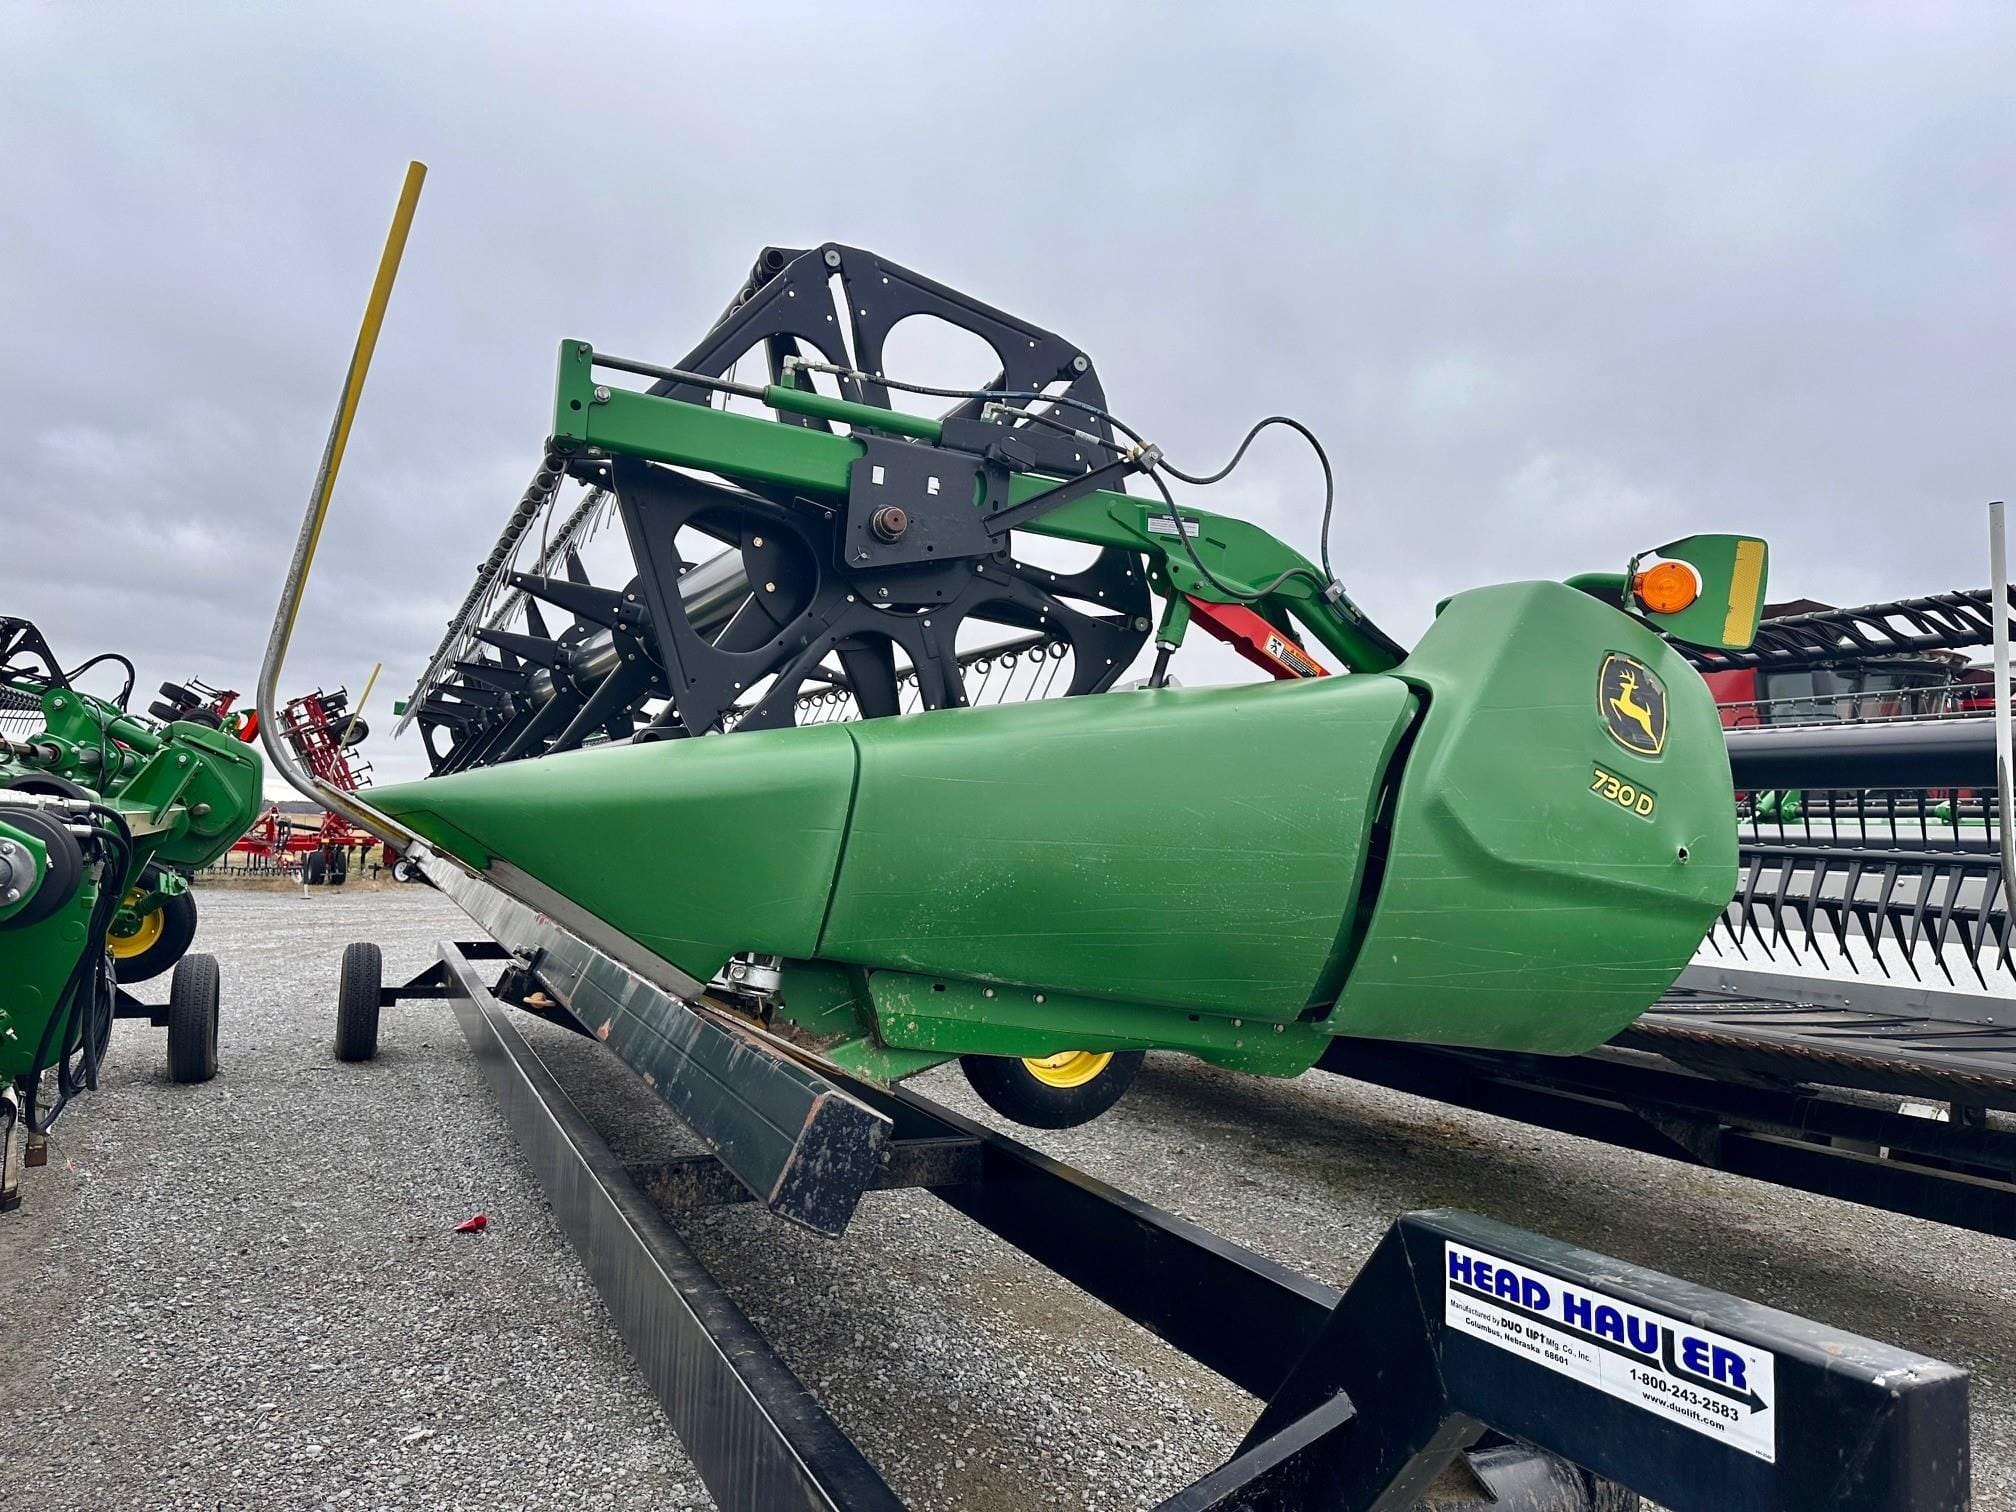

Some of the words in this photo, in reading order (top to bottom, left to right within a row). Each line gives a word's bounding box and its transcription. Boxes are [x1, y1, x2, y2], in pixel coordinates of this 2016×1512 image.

[1449, 1250, 1551, 1310] HEAD
[1563, 1291, 1747, 1391] HAULER
[1450, 1299, 1491, 1321] Manufactured
[1492, 1316, 1500, 1326] by
[1501, 1318, 1522, 1334] DUO
[1578, 1350, 1592, 1363] Inc.
[1465, 1317, 1503, 1339] Columbus,
[1504, 1333, 1541, 1354] Nebraska
[1544, 1350, 1569, 1366] 68601
[1630, 1368, 1739, 1422] 1-800-243-2583
[1642, 1391, 1725, 1431] www.duolift.com
